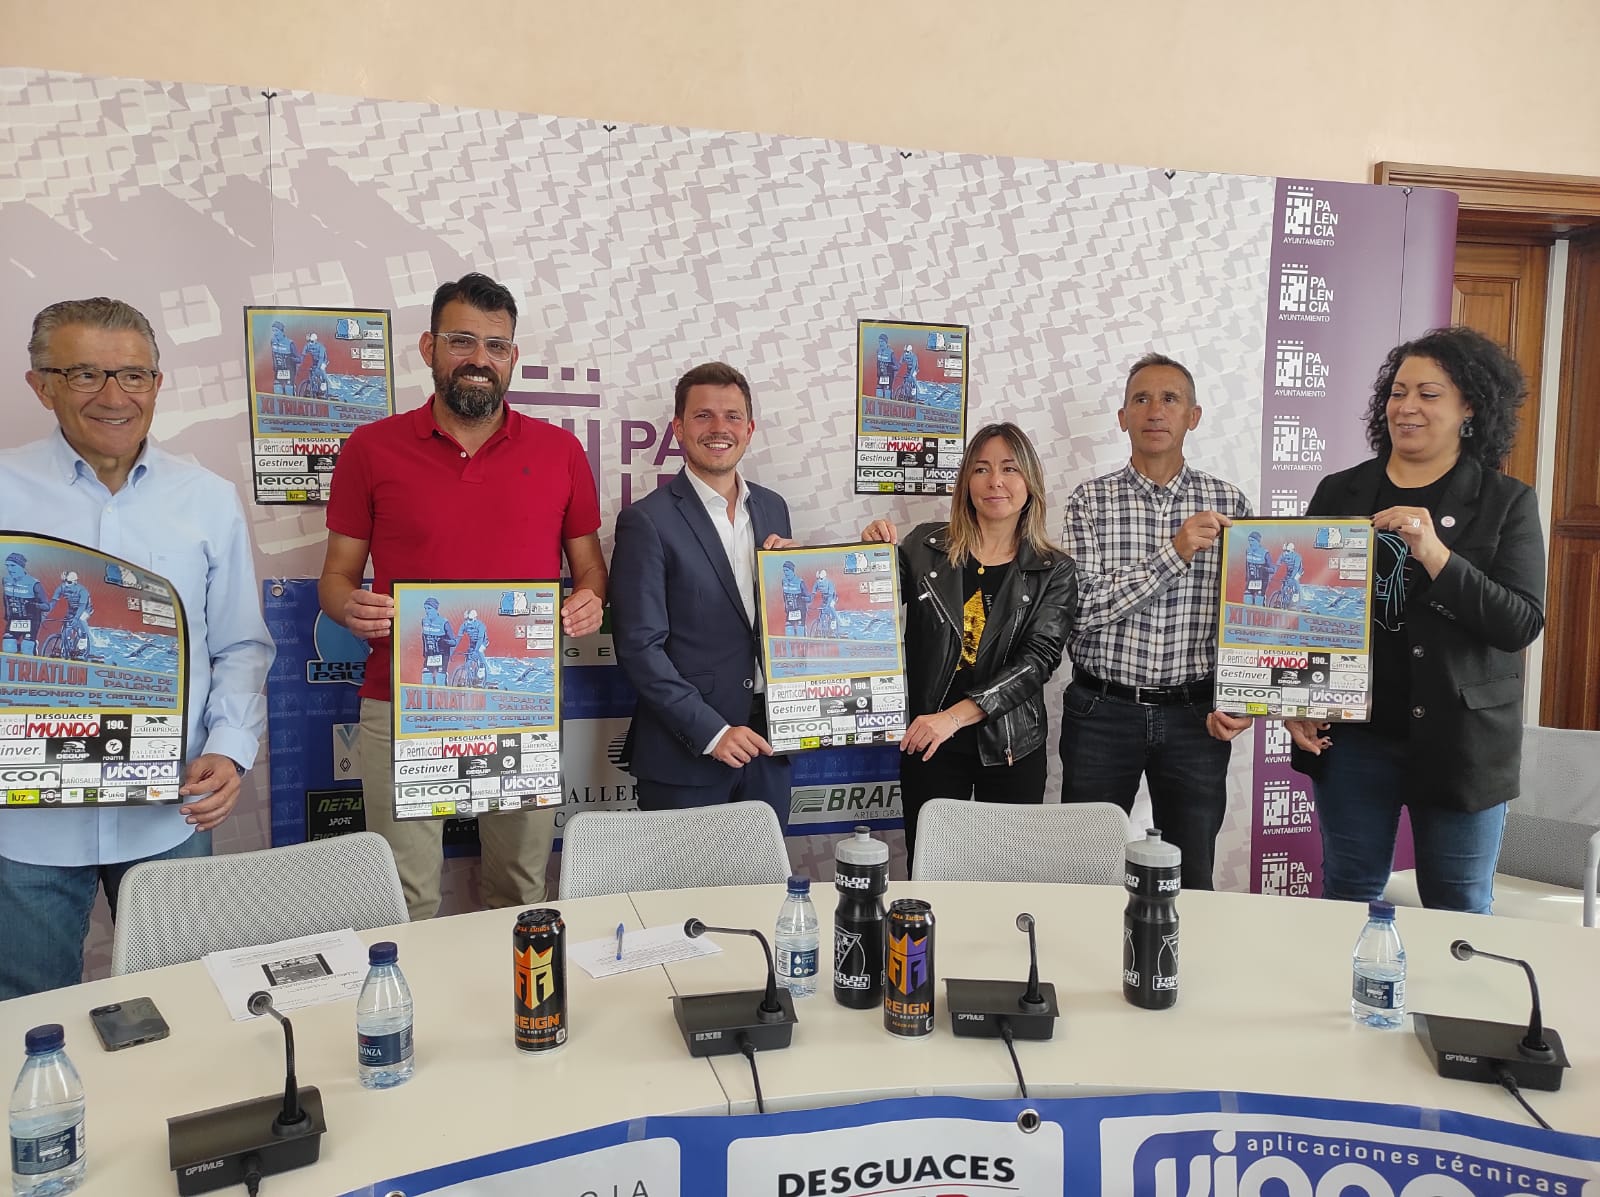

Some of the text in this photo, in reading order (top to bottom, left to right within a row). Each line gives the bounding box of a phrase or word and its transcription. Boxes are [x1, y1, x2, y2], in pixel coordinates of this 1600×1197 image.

[1315, 199, 1331, 212] PA
[1314, 213, 1338, 225] LEN
[1313, 224, 1334, 237] CIA
[1283, 236, 1335, 247] AYUNTAMIENTO
[1310, 276, 1326, 289] PA
[1309, 289, 1333, 301] LEN
[1308, 301, 1330, 313] CIA
[1278, 313, 1330, 323] AYUNTAMIENTO
[1306, 352, 1322, 364] PA
[1305, 364, 1329, 377] LEN
[1304, 376, 1326, 388] CIA
[1274, 389, 1326, 398] AYUNTAMIENTO
[1302, 427, 1318, 439] PA
[294, 444, 340, 455] MUNDO
[888, 441, 923, 452] MUNDO
[1301, 439, 1326, 450] LEN
[1301, 451, 1322, 462] CIA
[926, 467, 959, 480] vicapa
[1272, 464, 1323, 472] AYUNTAMIENTO
[311, 661, 366, 672] TRIA
[1259, 655, 1308, 669] MUNDO
[6, 658, 88, 686] TRIATLON
[95, 669, 173, 686] CIUDAD DE
[103, 679, 171, 693] PALENCIA
[807, 684, 852, 698] MUNDO
[405, 688, 422, 710] XI
[772, 704, 819, 715] Gestinver.
[26, 722, 100, 737] MUNDO
[0, 744, 41, 756] inver.
[443, 741, 497, 758] MUNDO
[0, 761, 178, 783] con vicapal
[399, 764, 456, 775] Gestinver.
[504, 772, 559, 792] vicapal
[1292, 790, 1307, 802] PA
[1291, 801, 1315, 813] LEN
[1291, 813, 1312, 825] CIA
[1263, 825, 1312, 836] AYUNTAMIENTO
[1290, 862, 1305, 873] PA
[1289, 872, 1312, 884] LEN
[1289, 883, 1310, 895] CIA
[885, 997, 930, 1015] REIGN
[1444, 1054, 1478, 1064] OPTIMUS
[185, 1159, 224, 1176] OPTIMUS
[1246, 1134, 1420, 1166] aplicaciones
[1435, 1152, 1568, 1196] técnicas
[778, 1153, 1016, 1197] DESGUACES
